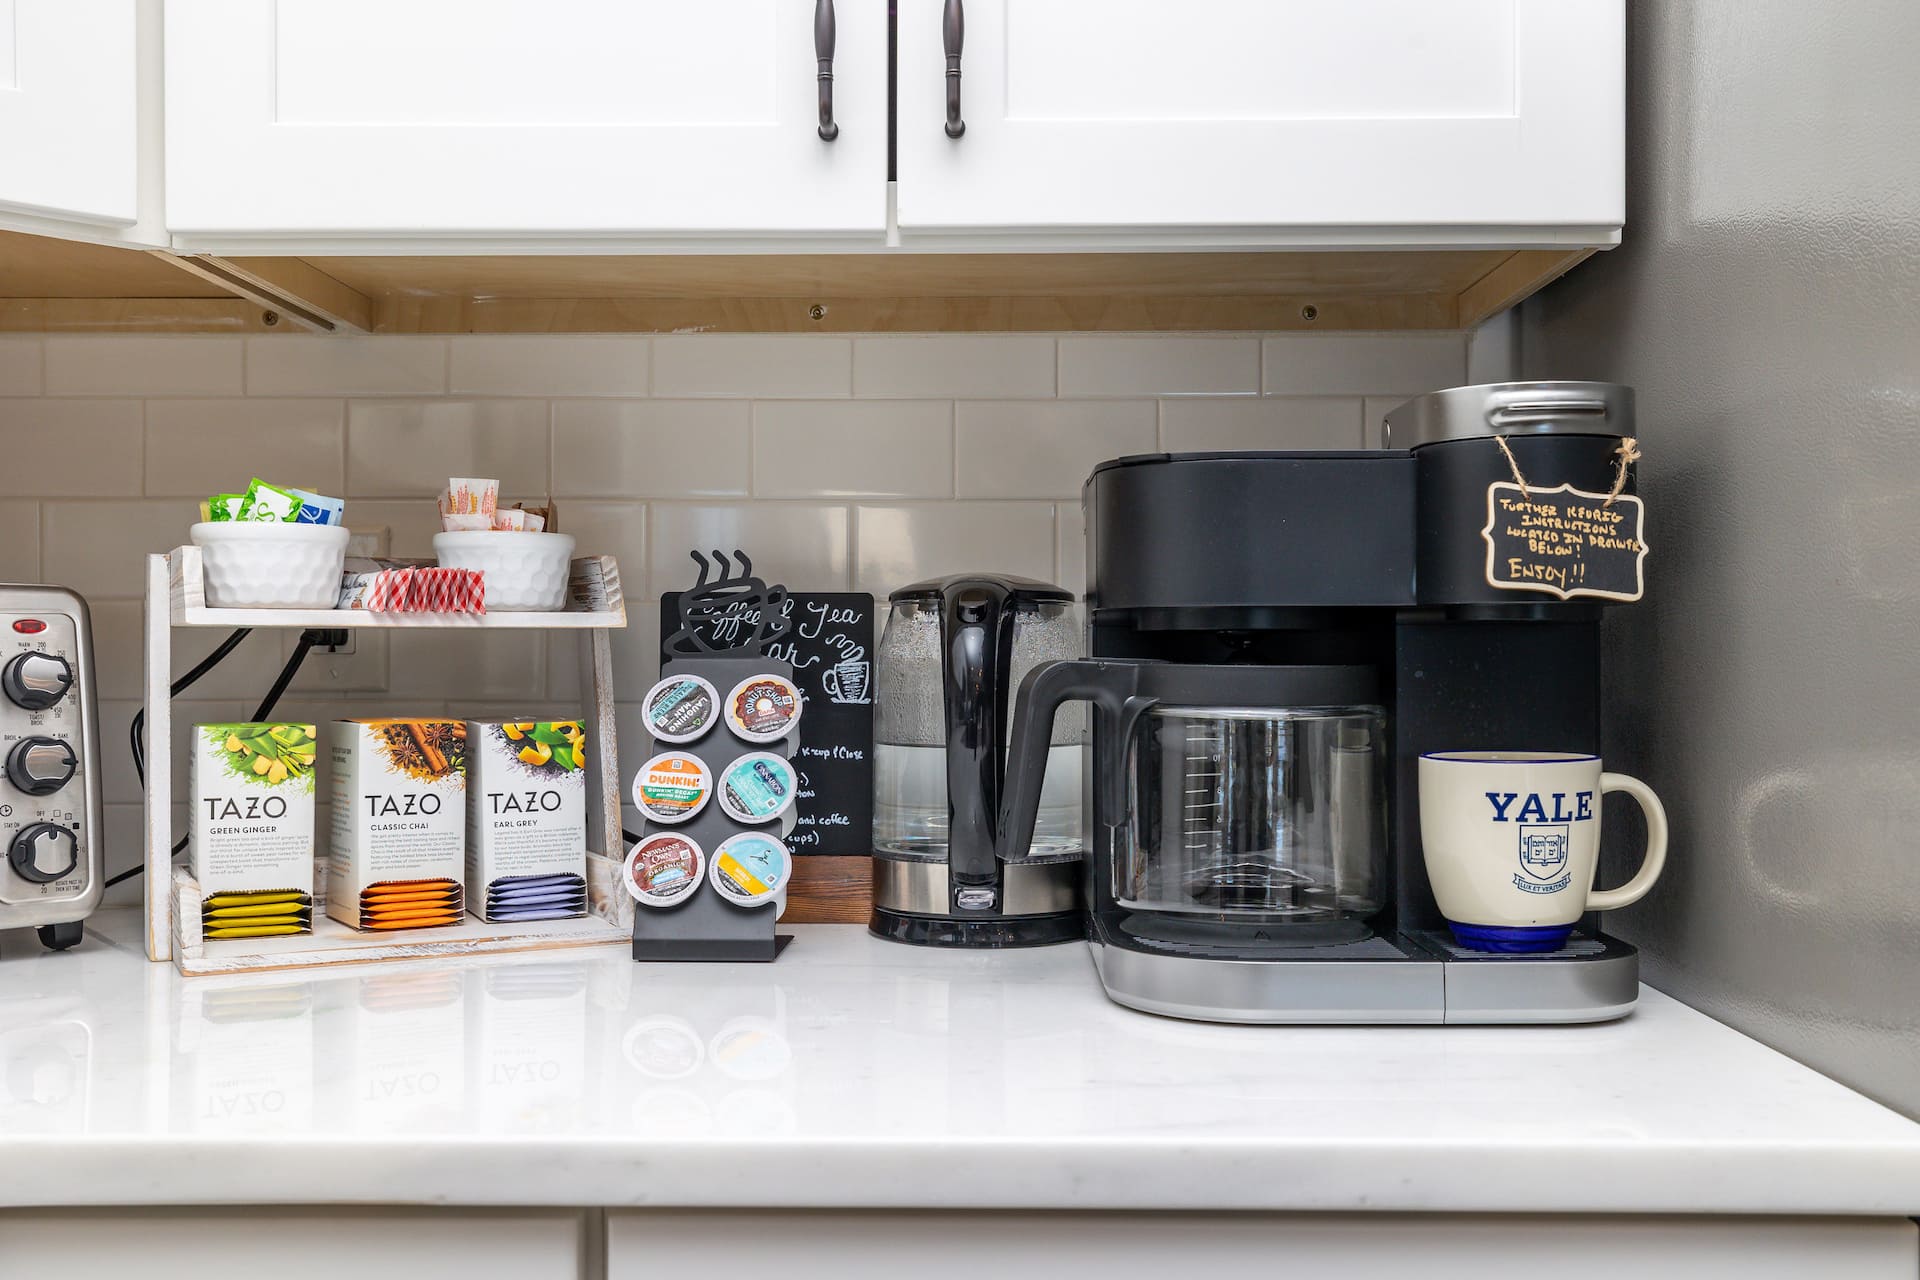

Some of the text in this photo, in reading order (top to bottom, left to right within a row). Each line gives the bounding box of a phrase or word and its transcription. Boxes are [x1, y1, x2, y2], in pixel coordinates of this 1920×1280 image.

[1521, 514, 1616, 536] INSTRUCTIONS
[1563, 532, 1583, 544] IN
[799, 599, 863, 638] Tea
[203, 796, 287, 820] TAZO
[365, 793, 440, 816] TAZO
[487, 791, 561, 814] TAZO
[1485, 791, 1593, 822] YALE
[371, 823, 407, 831] CLASSIC
[819, 812, 850, 825] coffee
[210, 826, 277, 835] GREEN GINGER
[1520, 881, 1531, 889] LUX
